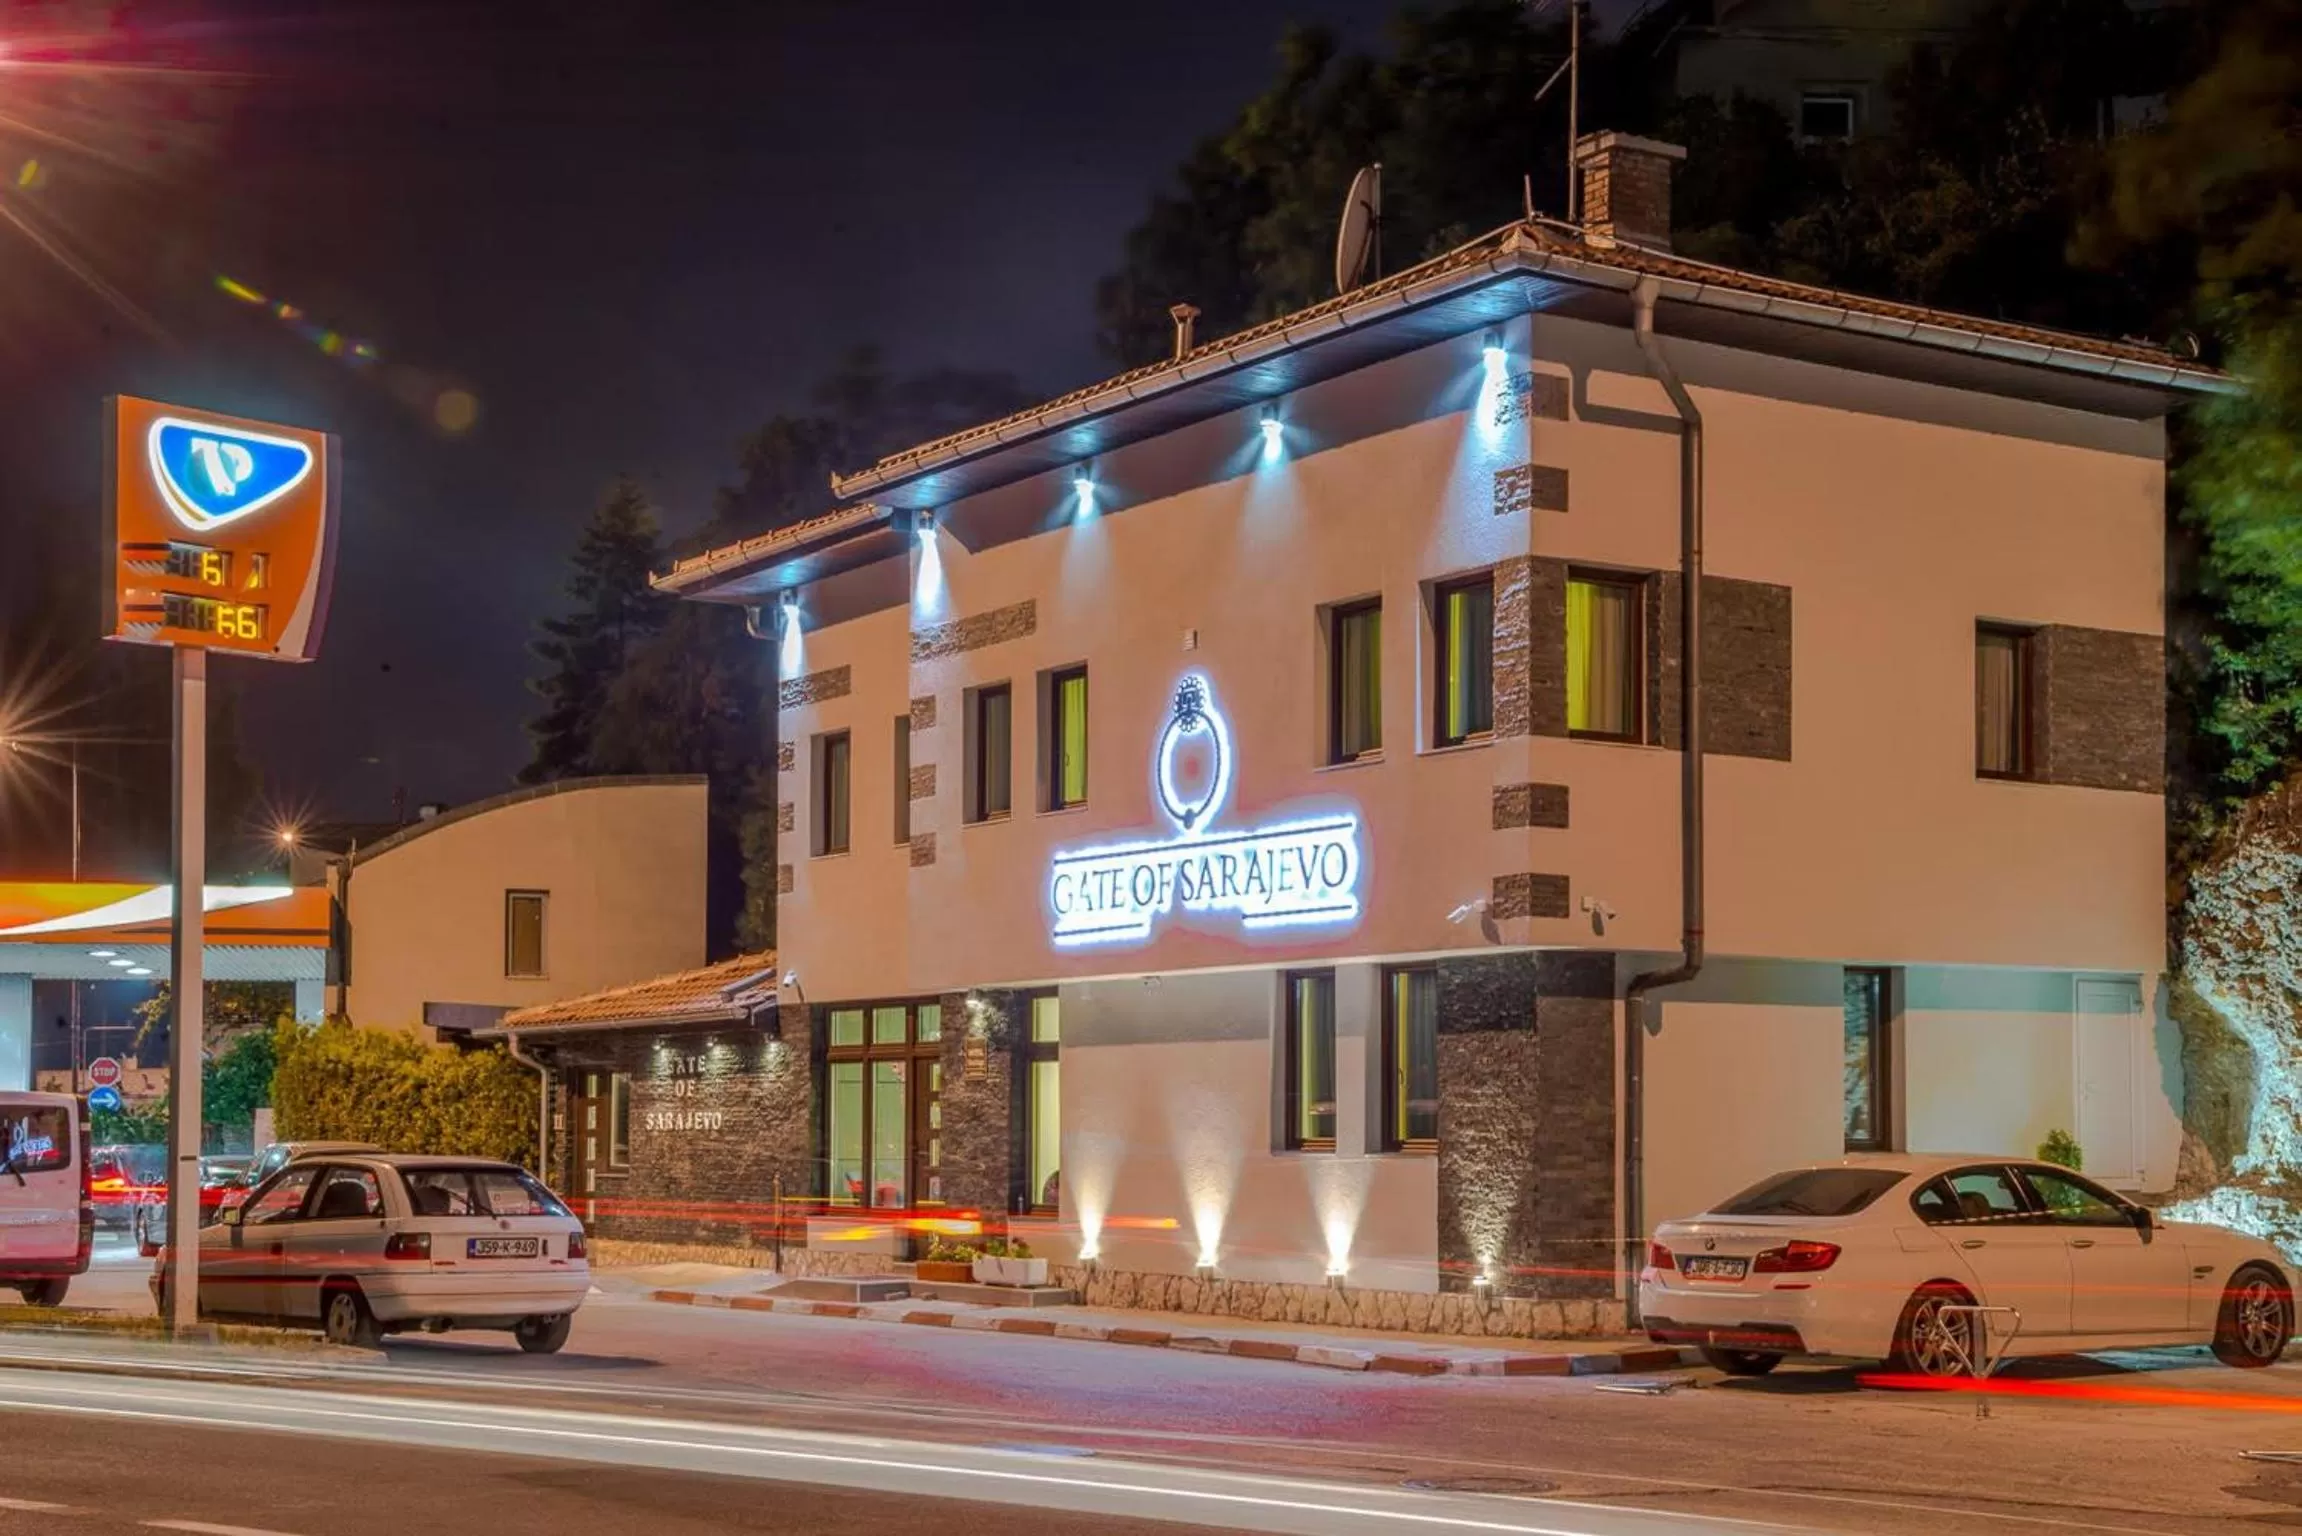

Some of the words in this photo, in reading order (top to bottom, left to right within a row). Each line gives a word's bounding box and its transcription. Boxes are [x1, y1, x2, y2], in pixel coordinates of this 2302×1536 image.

[1053, 867, 1125, 914] GATE
[1132, 862, 1173, 907] OF
[1179, 842, 1349, 905] SARAJEVO
[94, 1067, 116, 1077] STOP
[675, 1080, 696, 1097] OF
[646, 1111, 722, 1131] SARAJEVO
